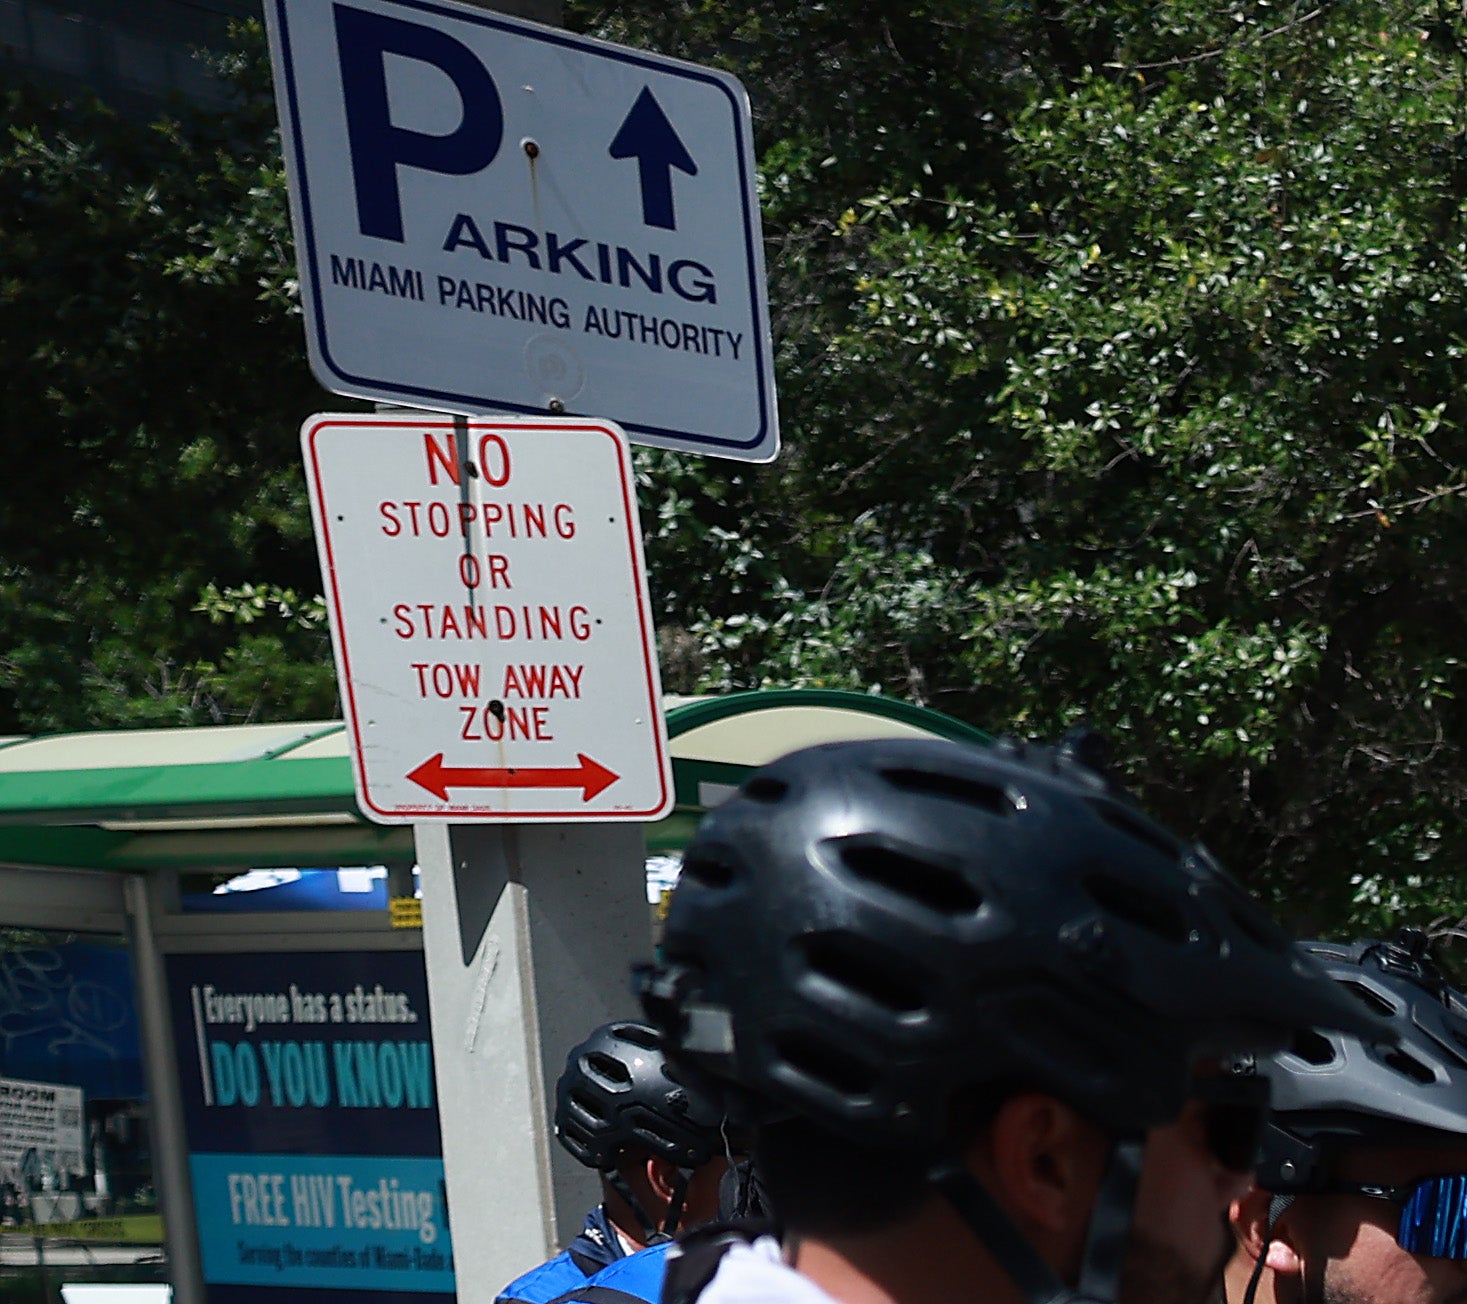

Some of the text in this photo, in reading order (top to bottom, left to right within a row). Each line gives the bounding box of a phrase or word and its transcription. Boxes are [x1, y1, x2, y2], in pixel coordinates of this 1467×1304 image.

[330, 254, 744, 361] MIAMI PARKING AUTHORITY
[426, 433, 512, 488] NO
[380, 502, 577, 540] STOPPING
[459, 553, 512, 591] OR
[392, 604, 592, 642] STANDING
[410, 664, 586, 699] TOW AWAY
[460, 705, 554, 742] ZONE
[203, 983, 418, 1032] Everyone has a status.
[210, 1040, 433, 1109] DO YOU KNOW
[227, 1173, 438, 1243] FREE HIV Testing
